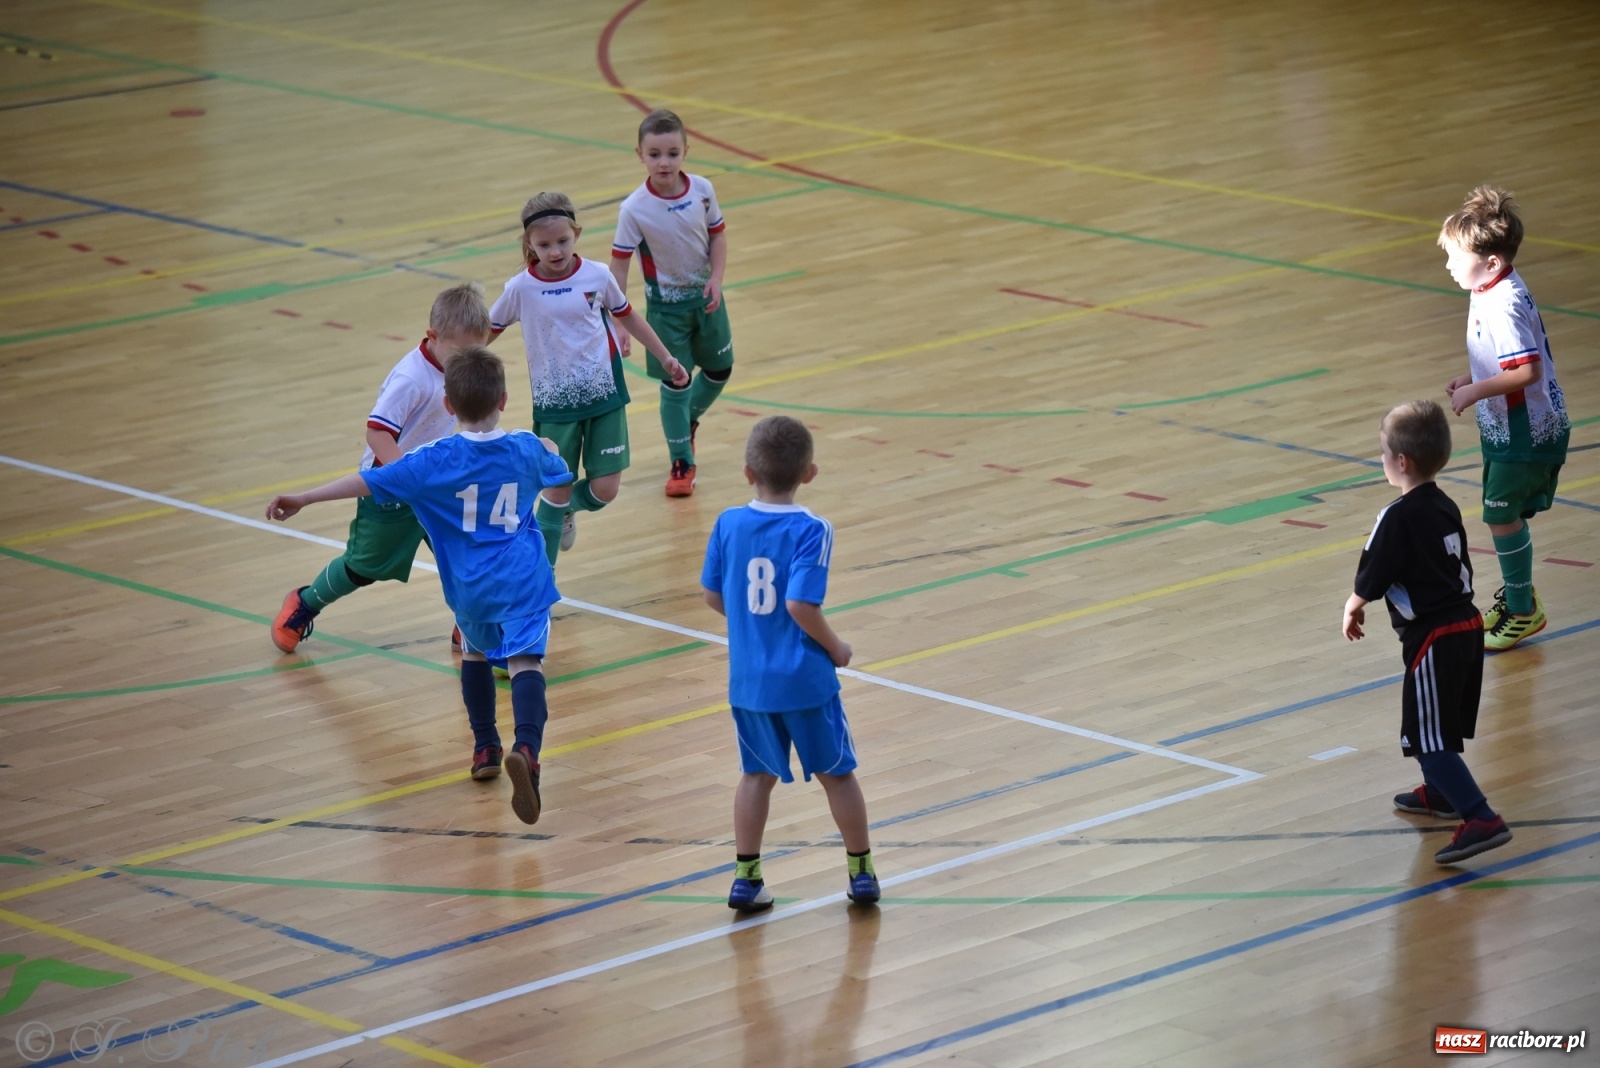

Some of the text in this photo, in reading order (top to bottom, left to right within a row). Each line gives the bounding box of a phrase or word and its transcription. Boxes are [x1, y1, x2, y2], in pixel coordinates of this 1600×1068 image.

[541, 287, 573, 296] regio
[455, 482, 521, 534] 14
[747, 557, 777, 615] 8
